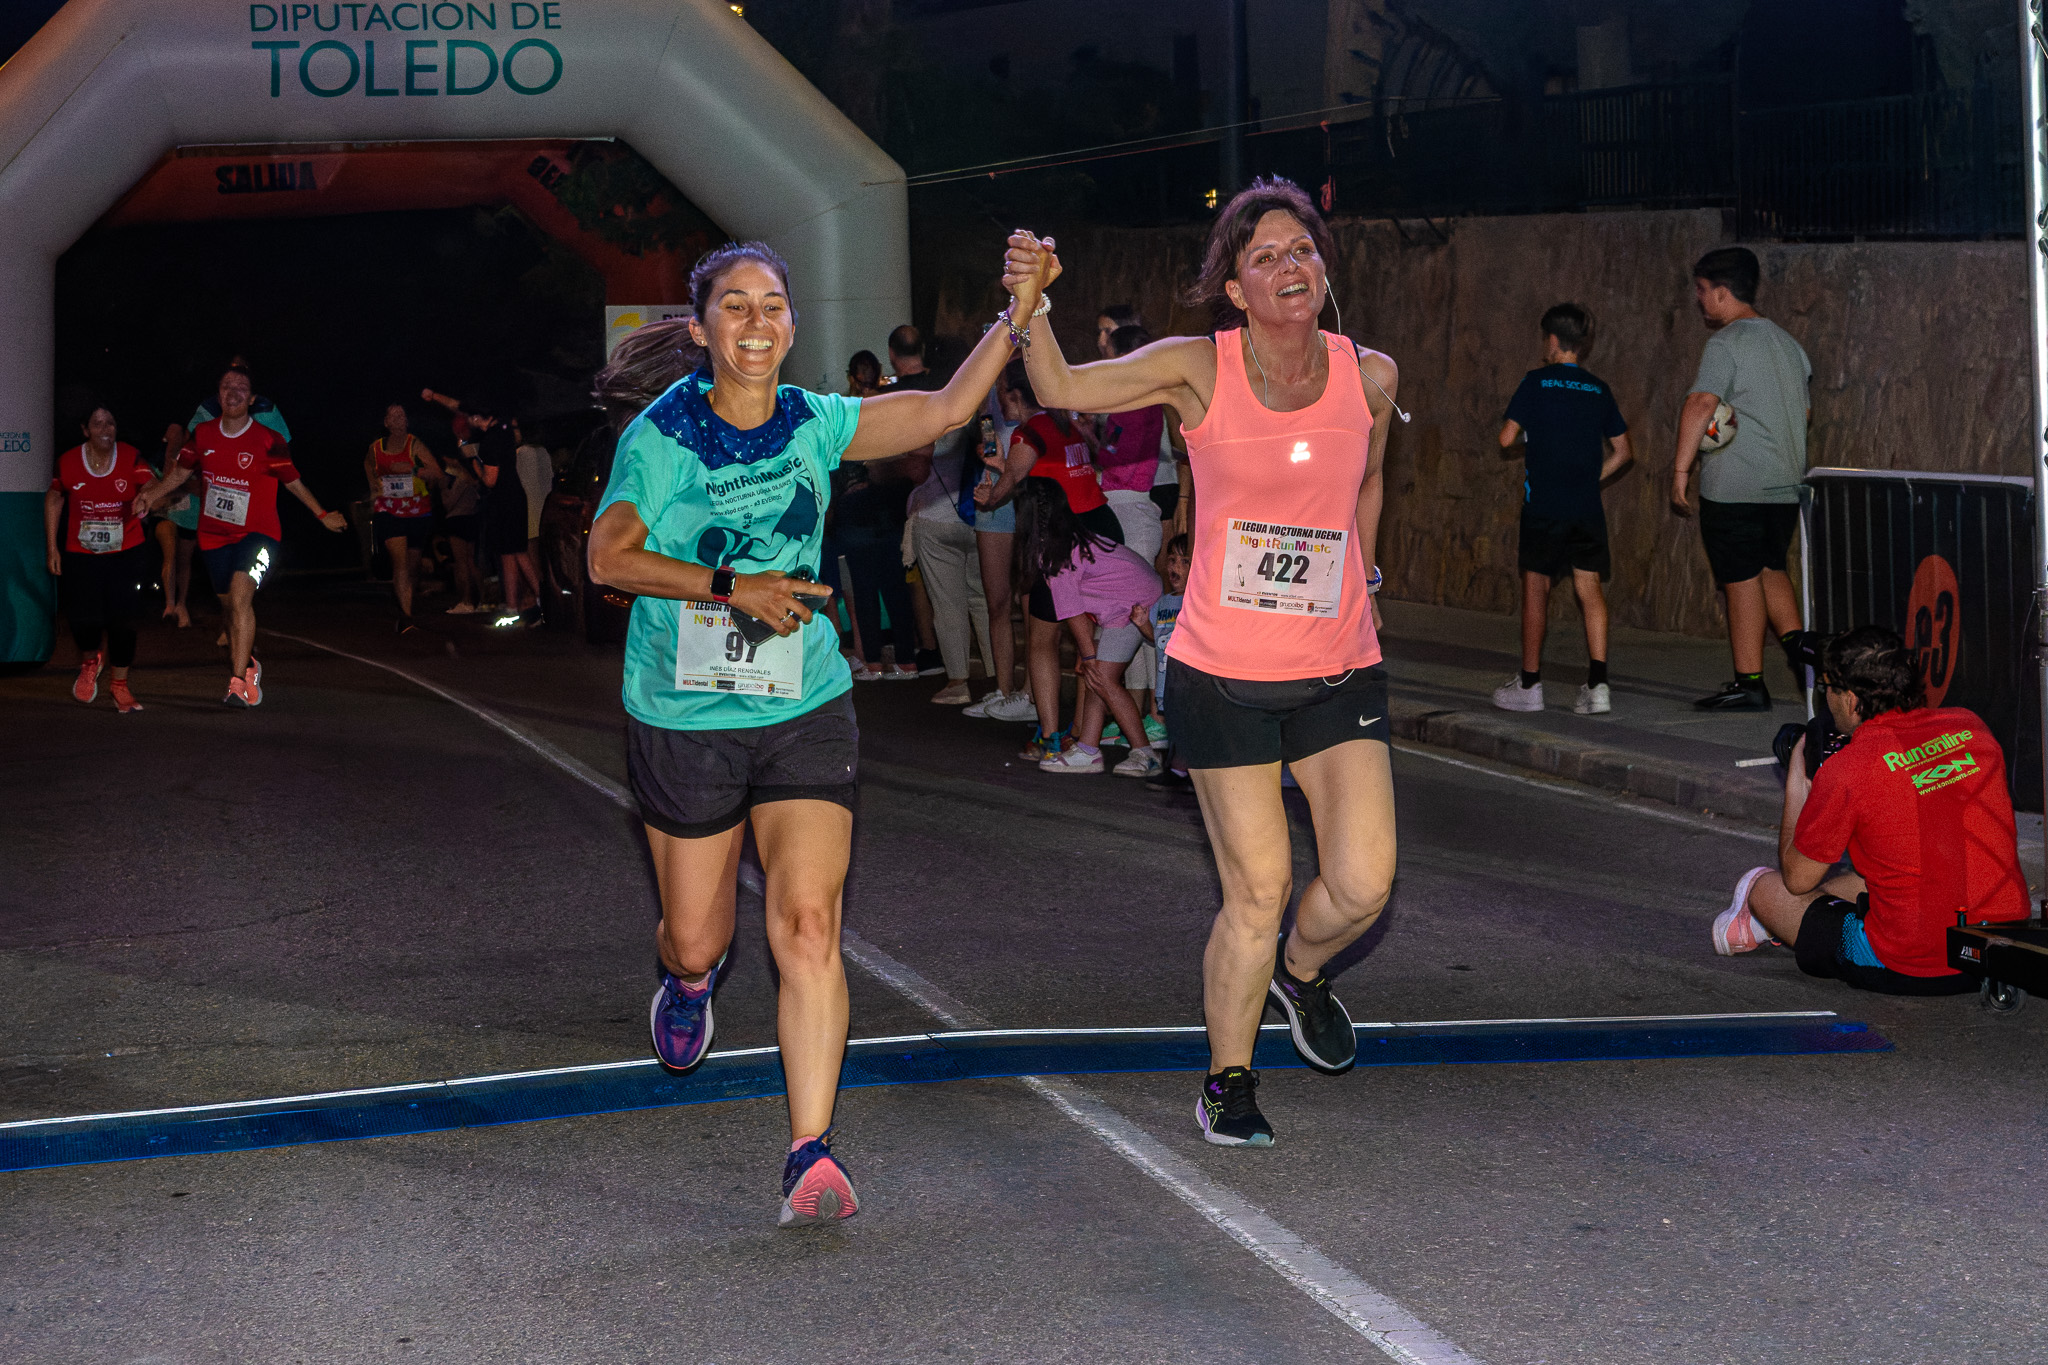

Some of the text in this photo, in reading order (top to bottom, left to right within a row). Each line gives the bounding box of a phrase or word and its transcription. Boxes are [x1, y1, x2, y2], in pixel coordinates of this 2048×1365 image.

[250, 0, 562, 32] DIPUTACIÓN DE
[251, 38, 564, 98] TOLEDO
[1541, 379, 1565, 388] REAL
[216, 497, 235, 511] 278
[724, 491, 756, 505] NOCTURNA
[90, 531, 111, 543] 299
[1232, 520, 1343, 541] XI LEGUA NOCTURNA UGENA
[1257, 552, 1310, 584] 422
[737, 667, 771, 676] RENOVALES
